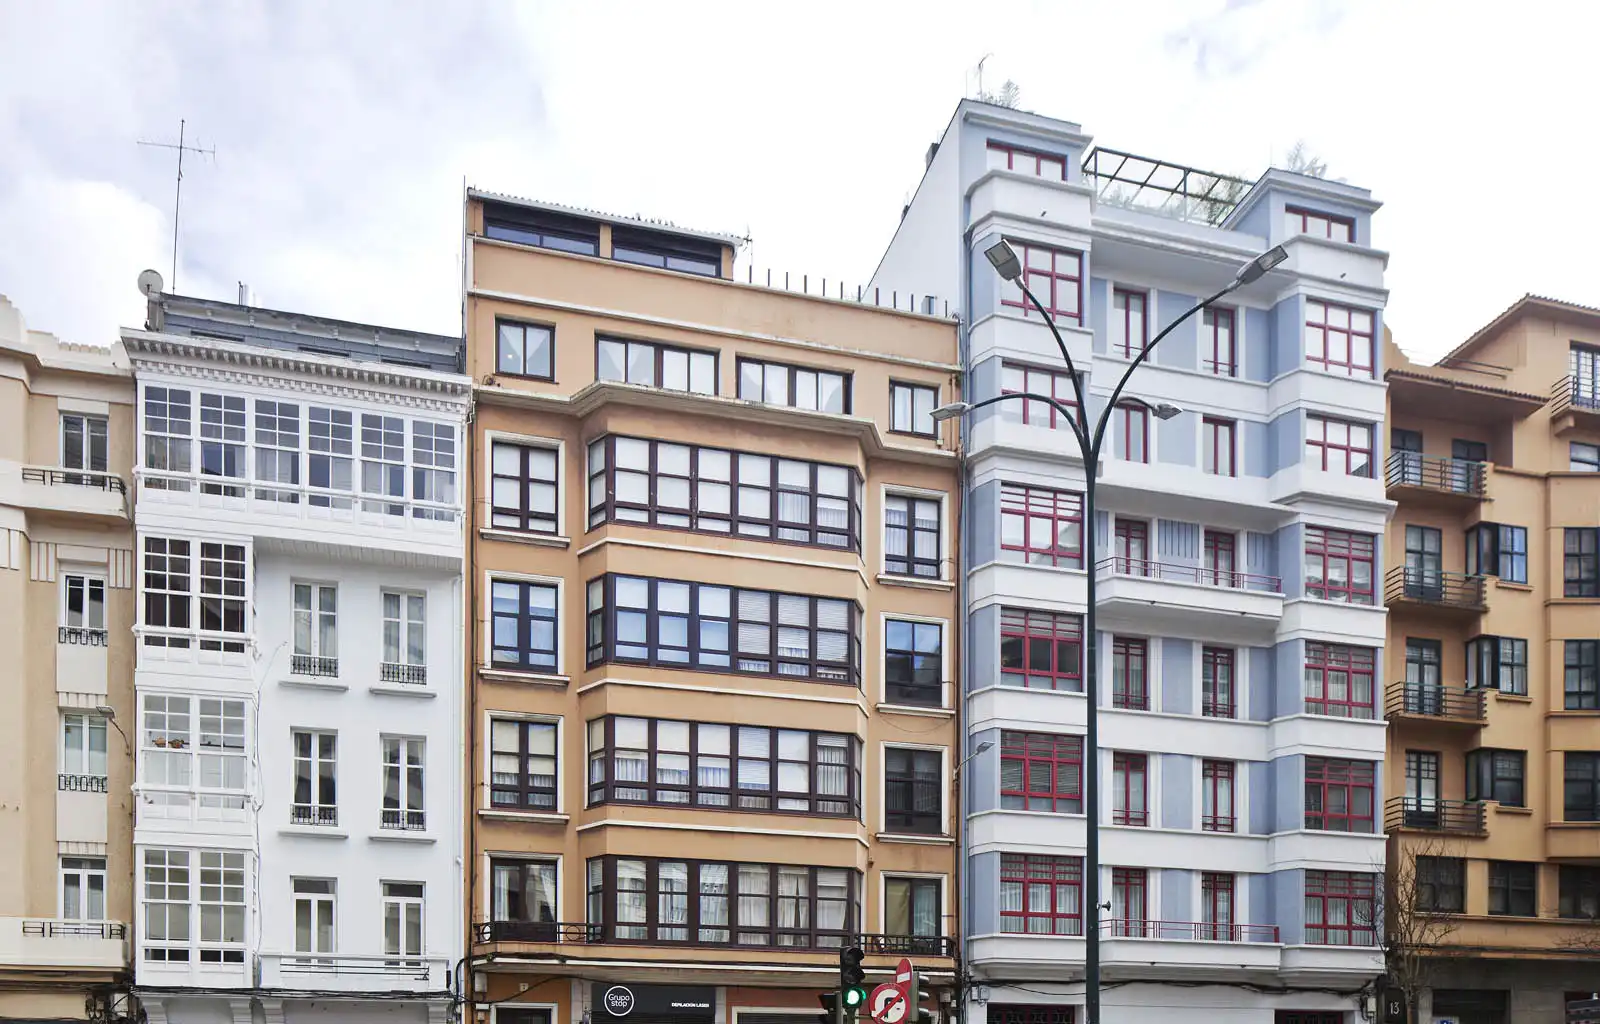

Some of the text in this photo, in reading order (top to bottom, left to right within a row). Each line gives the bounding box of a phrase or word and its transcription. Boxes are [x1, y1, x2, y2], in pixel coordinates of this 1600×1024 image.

[608, 993, 630, 1002] Grupo
[611, 1000, 628, 1008] stop
[1390, 1001, 1400, 1015] 13
